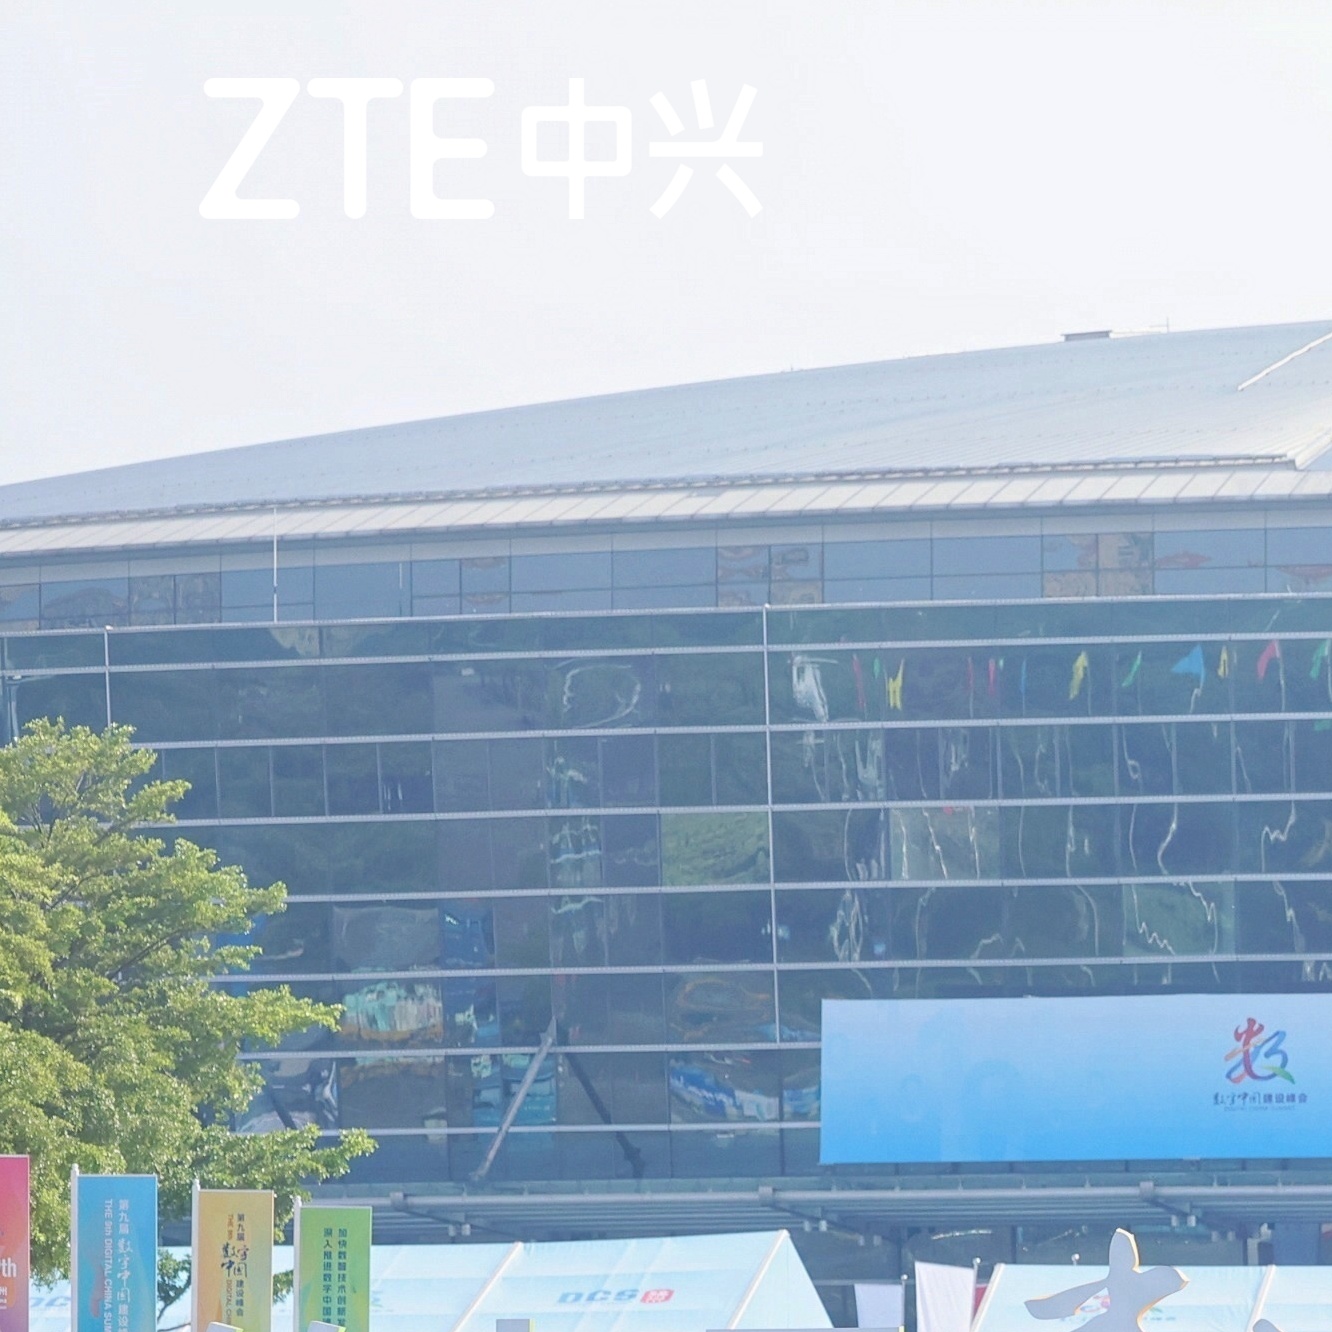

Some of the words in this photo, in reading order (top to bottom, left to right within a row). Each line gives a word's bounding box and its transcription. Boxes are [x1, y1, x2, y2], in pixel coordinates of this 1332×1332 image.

[104, 1199, 112, 1218] THE
[0, 1257, 17, 1278] th
[104, 1238, 112, 1276] DIGITAL
[104, 1278, 112, 1310] CHINA
